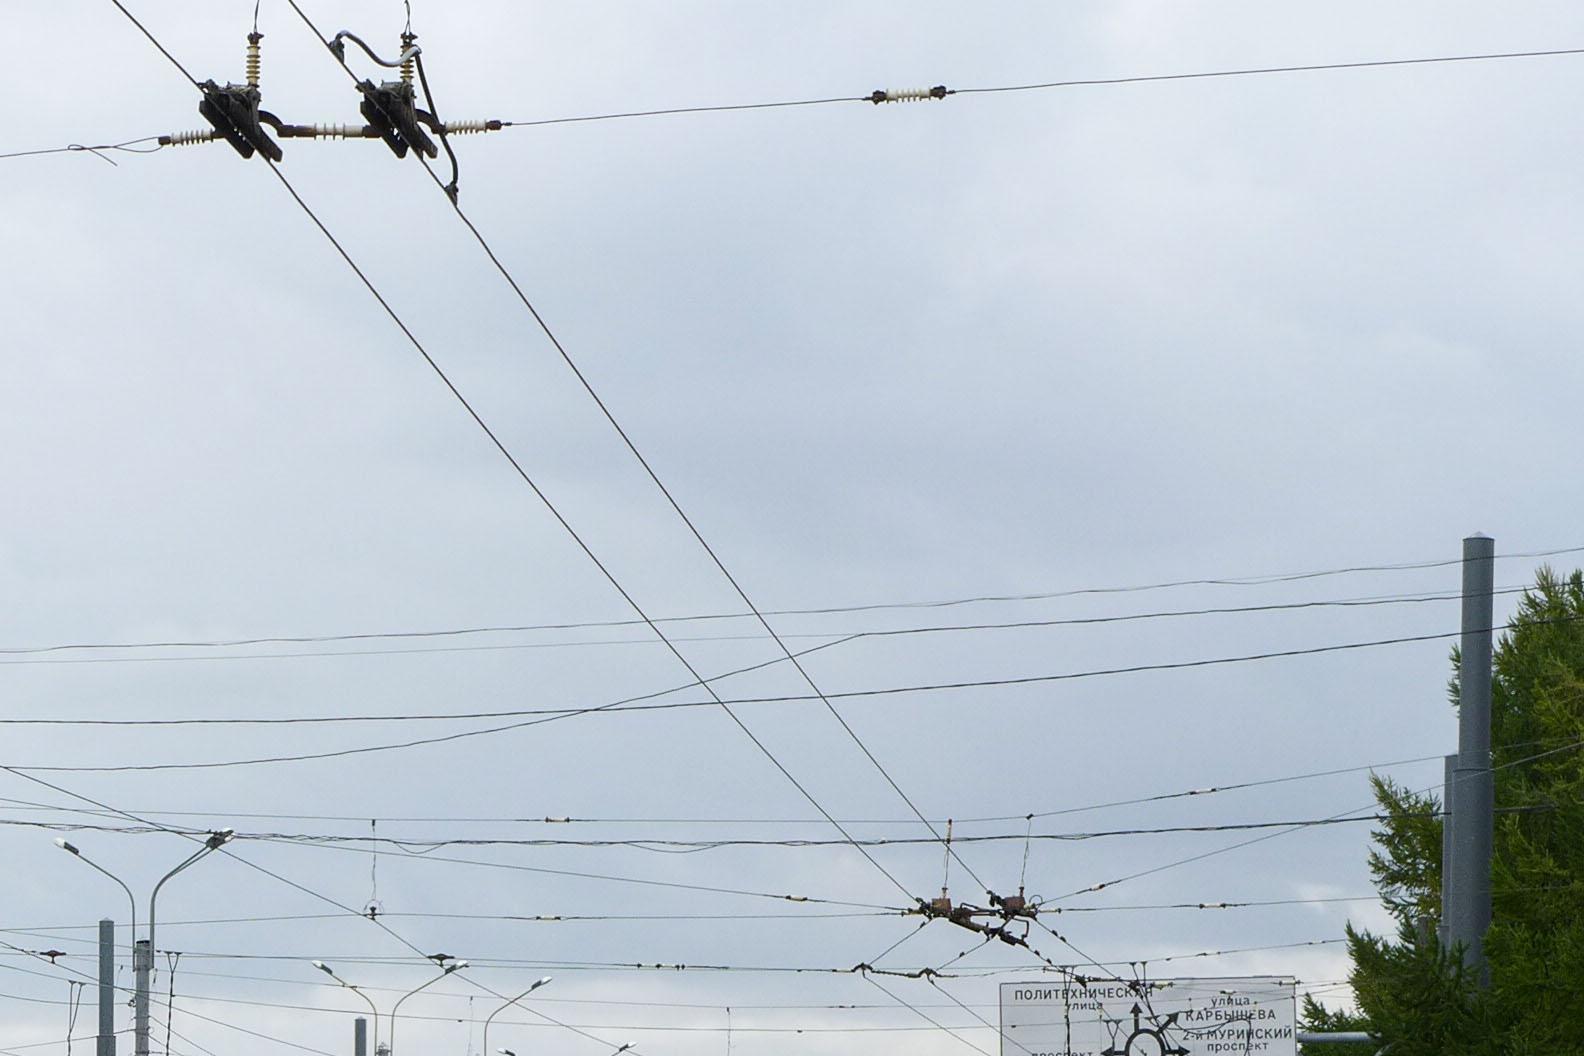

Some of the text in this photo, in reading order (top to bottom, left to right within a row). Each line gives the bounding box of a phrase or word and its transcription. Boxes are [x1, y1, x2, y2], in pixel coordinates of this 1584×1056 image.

[1066, 1002, 1103, 1011] улица
[1211, 997, 1250, 1007] улица
[1185, 1009, 1276, 1021] КАРБЫШЕВА
[1207, 1025, 1293, 1040] МУРИНСКИЙ
[1207, 1042, 1269, 1053] проспект
